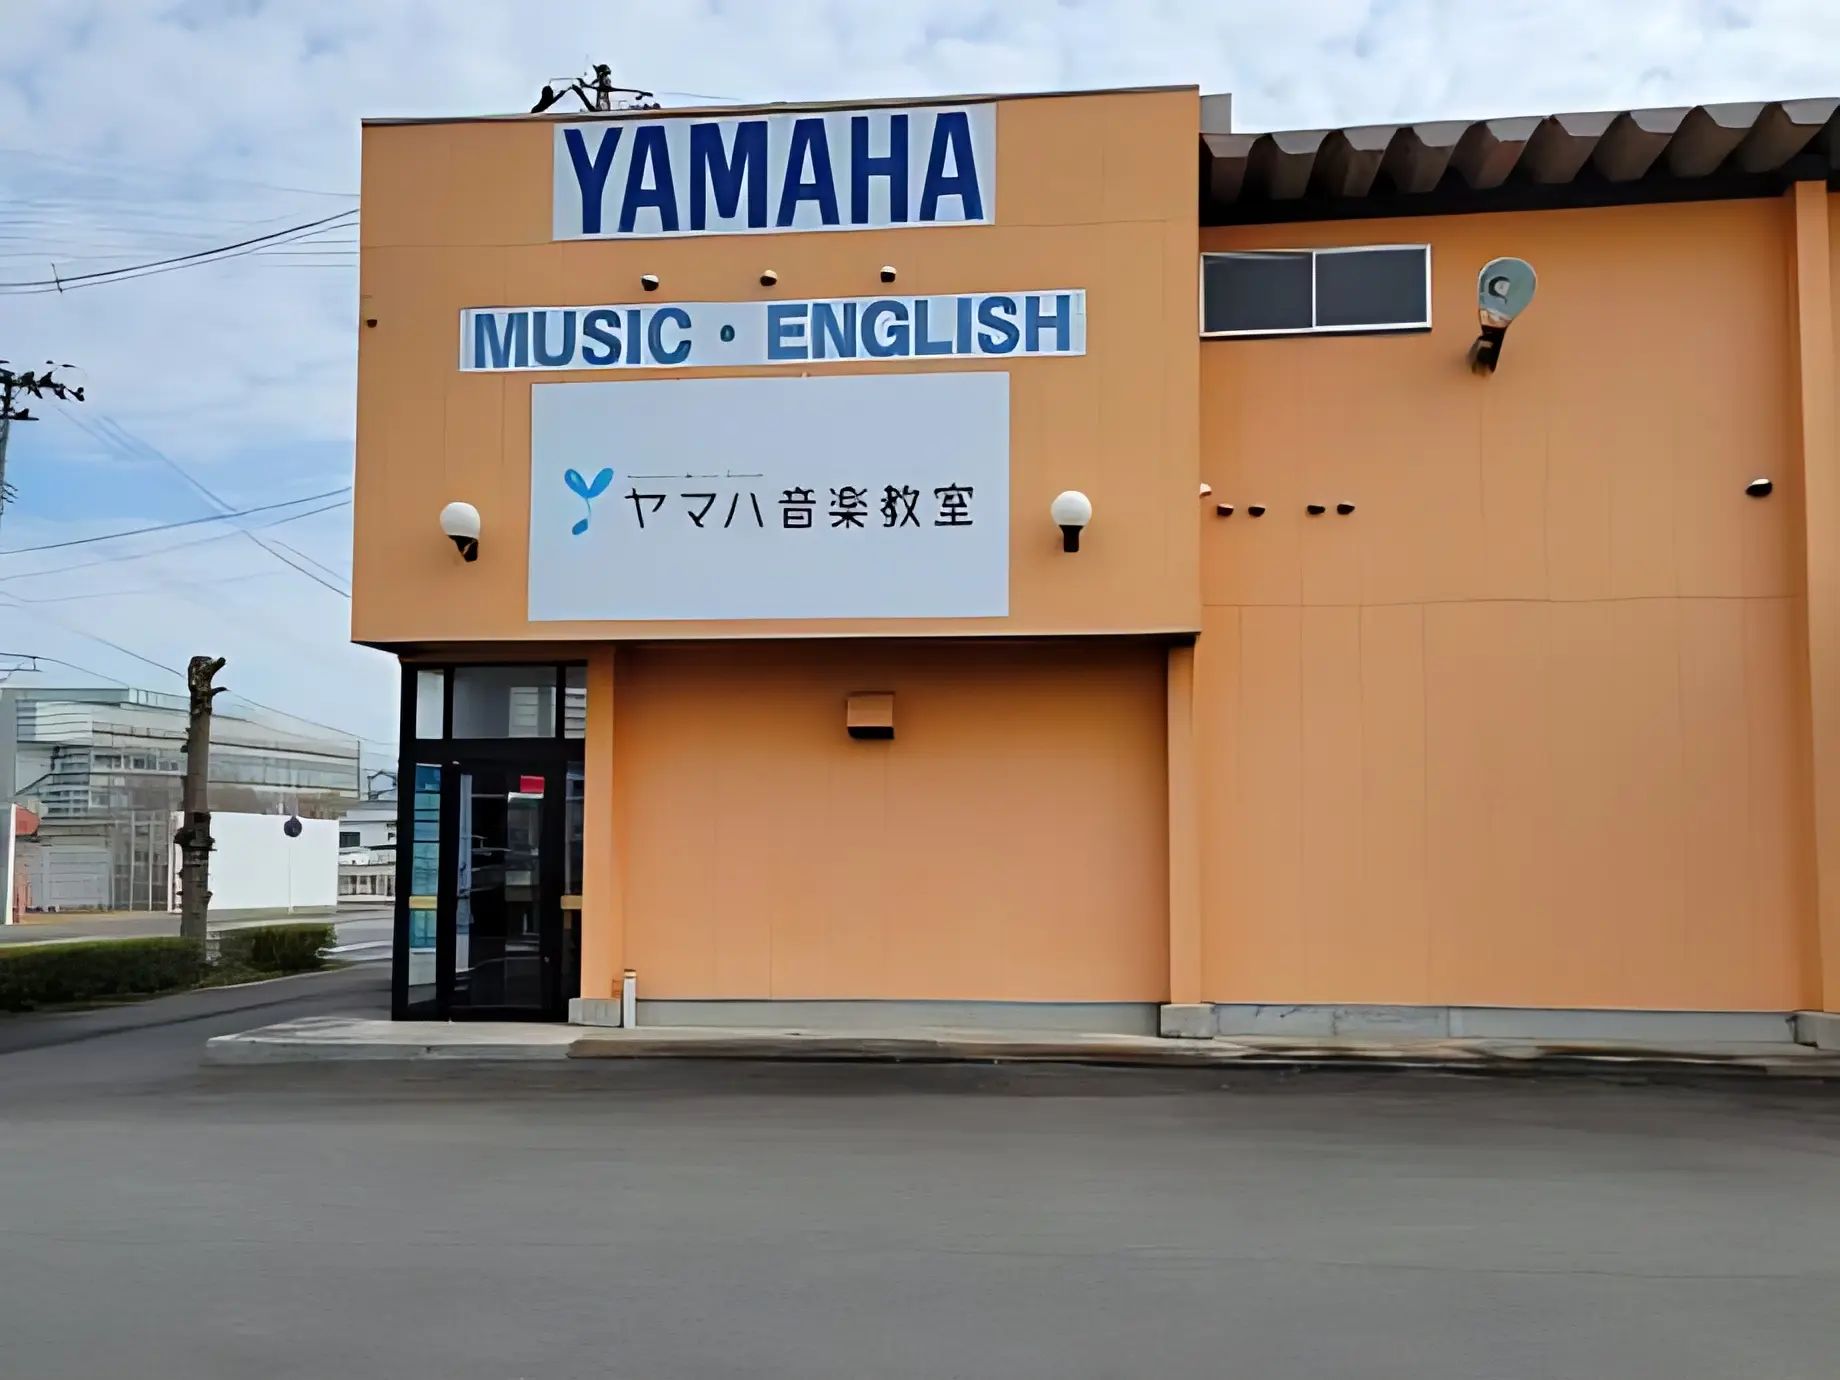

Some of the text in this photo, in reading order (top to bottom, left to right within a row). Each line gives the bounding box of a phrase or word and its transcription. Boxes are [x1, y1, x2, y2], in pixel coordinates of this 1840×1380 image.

[563, 111, 984, 235] YAMAHA
[474, 307, 692, 369] MUSIC
[767, 294, 1071, 360] ENGLISH
[624, 485, 976, 529] ヤマハ音楽教室
